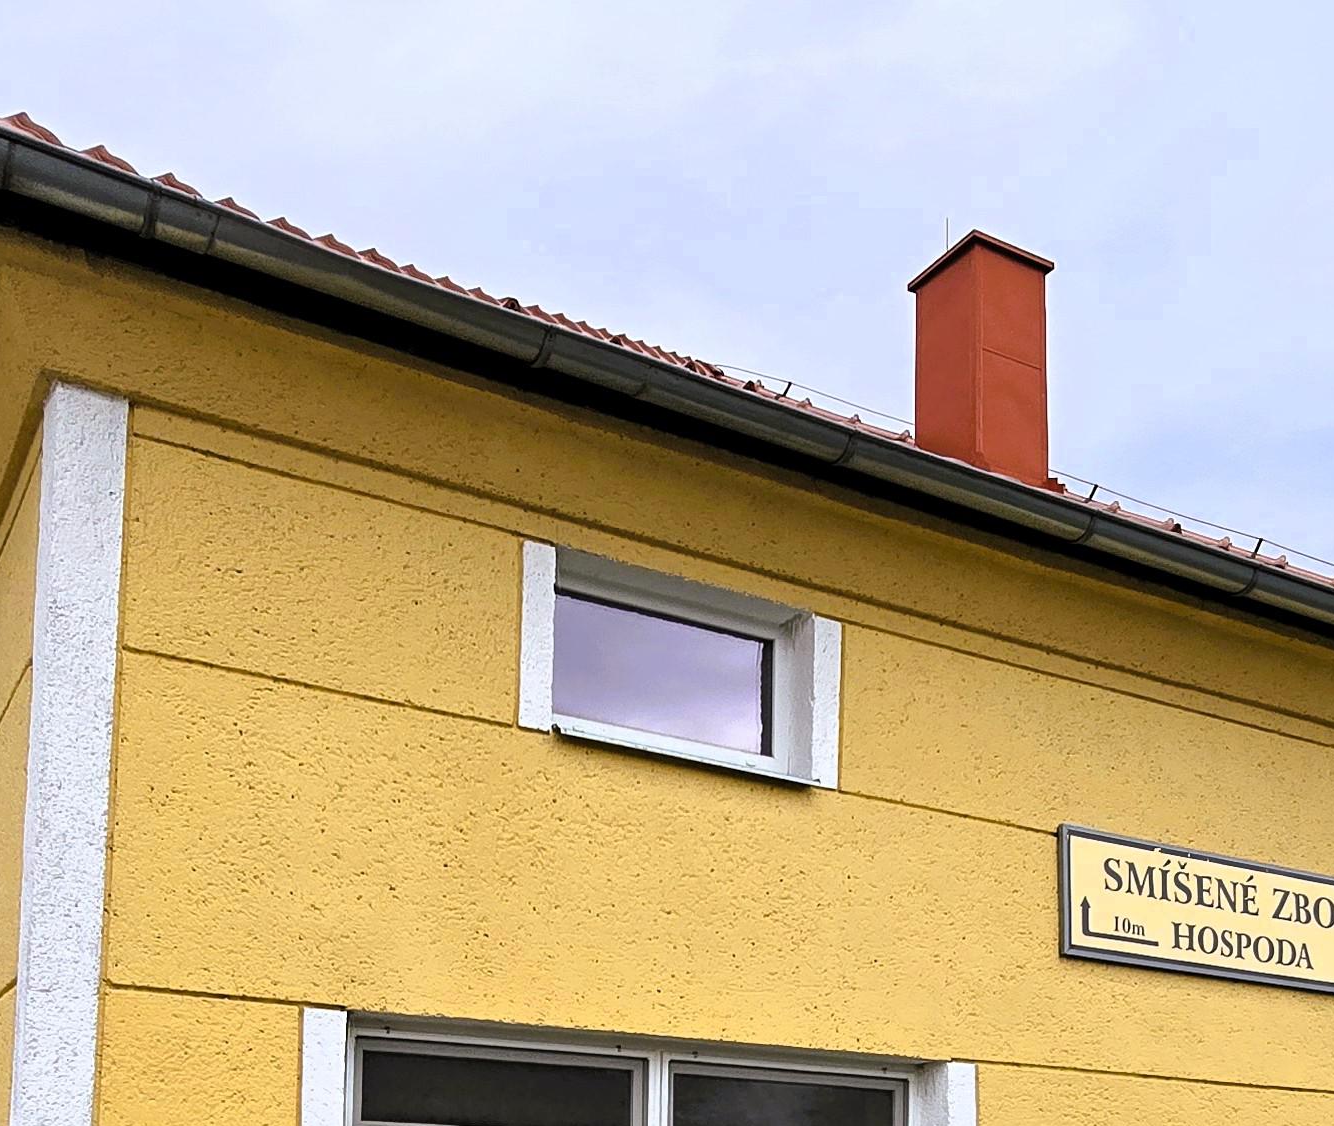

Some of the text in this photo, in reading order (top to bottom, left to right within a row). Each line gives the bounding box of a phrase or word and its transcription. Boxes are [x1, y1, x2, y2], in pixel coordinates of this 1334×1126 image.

[1103, 856, 1260, 917] SMÍŠENÉ
[1113, 915, 1146, 937] 10m
[1171, 921, 1315, 970] HOSPODA
